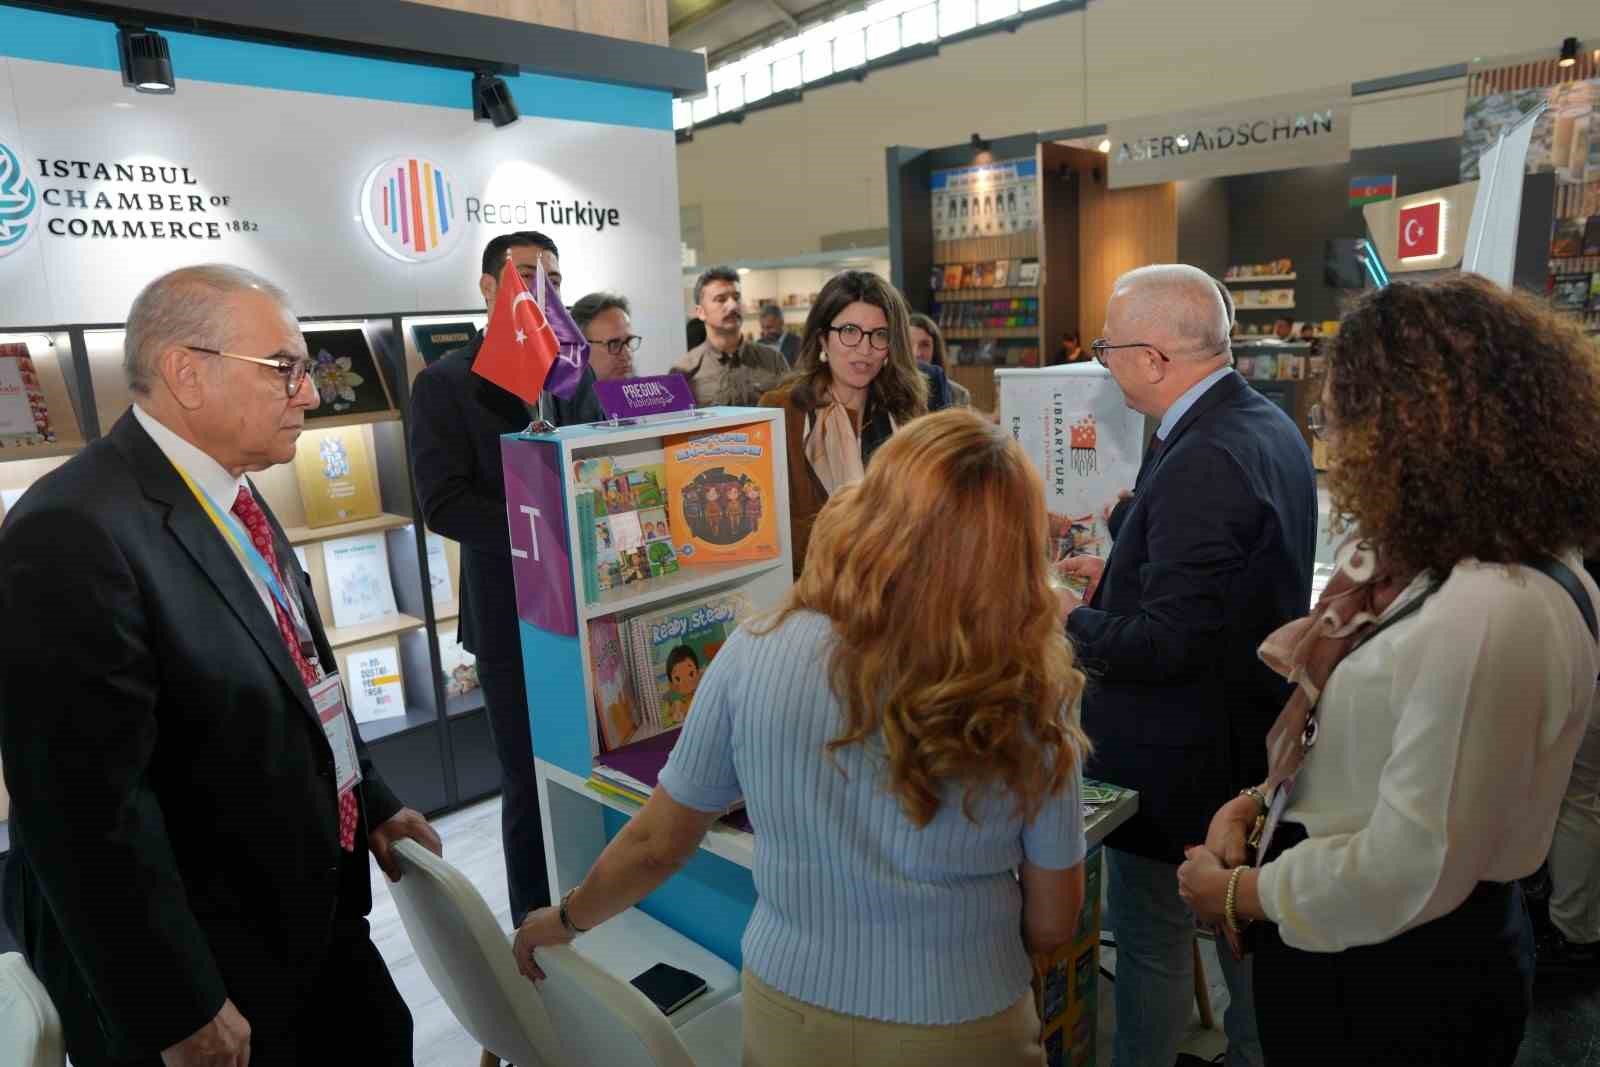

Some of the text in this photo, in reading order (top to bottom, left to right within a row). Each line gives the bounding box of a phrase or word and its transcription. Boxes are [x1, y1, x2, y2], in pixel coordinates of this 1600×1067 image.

[1118, 109, 1332, 162] ASERBAIDSCHAN
[37, 158, 197, 185] ISTANBUL
[42, 188, 231, 212] CHAMBER OF
[466, 197, 620, 231] Read Türkiye
[48, 218, 259, 239] COMMERCE 1882
[622, 382, 661, 398] PREGON
